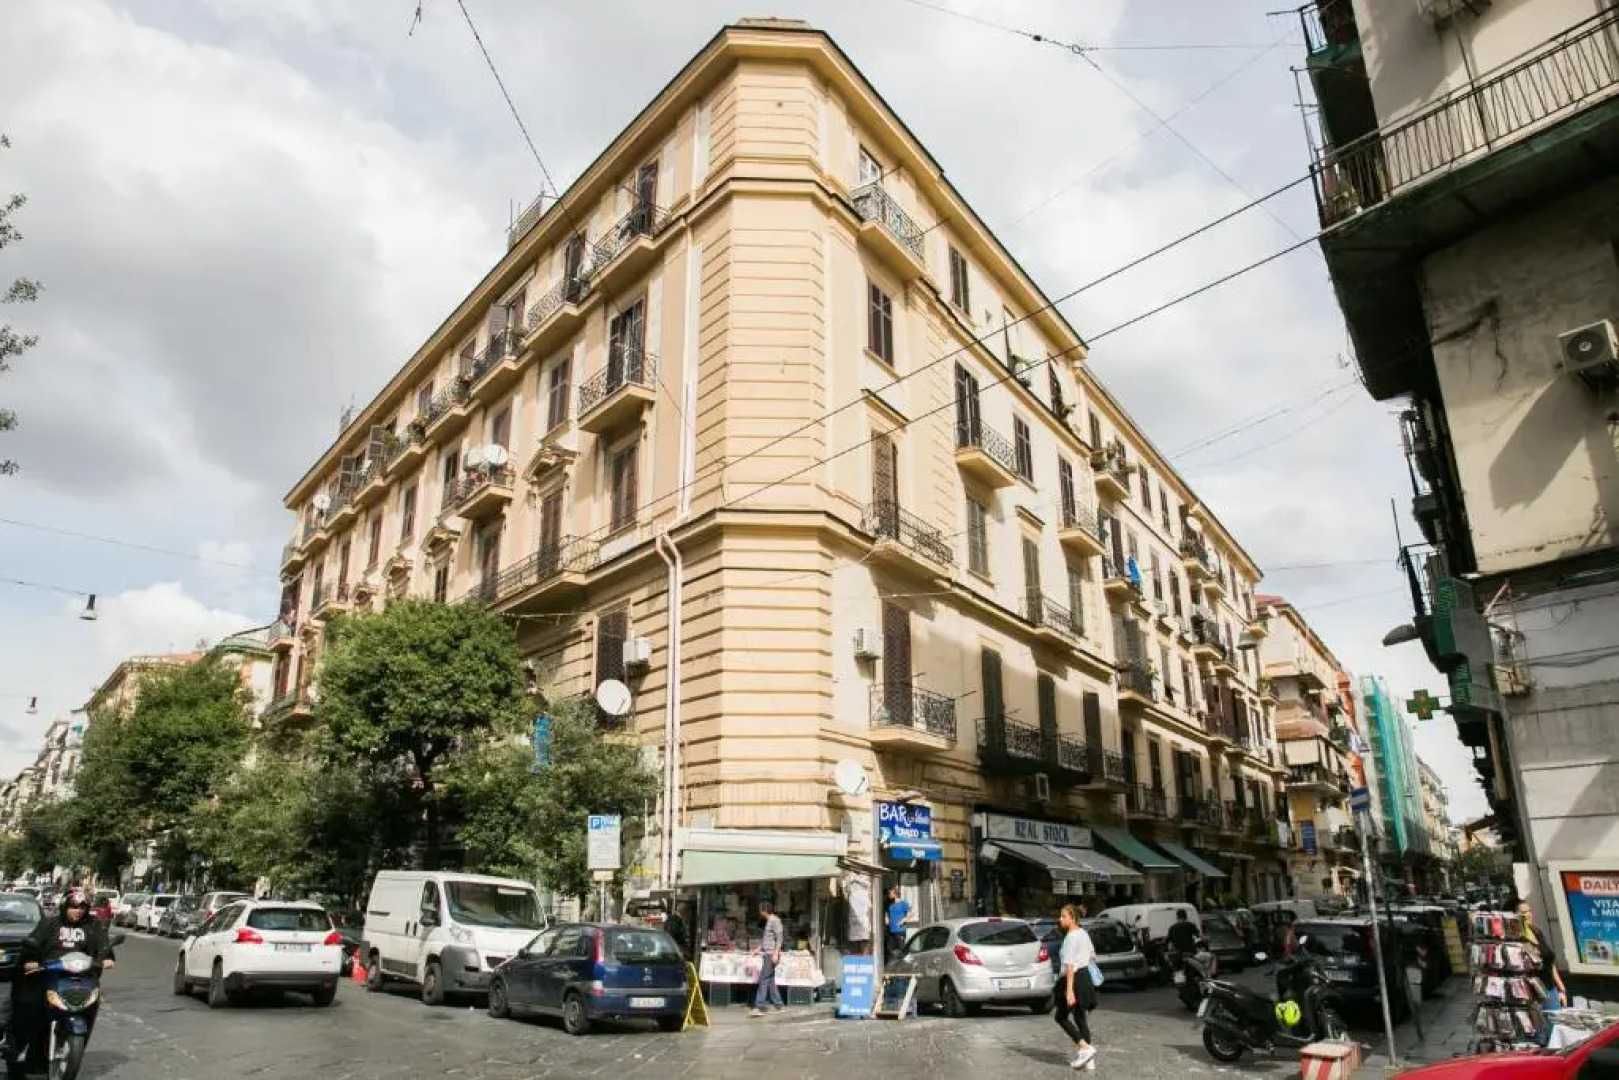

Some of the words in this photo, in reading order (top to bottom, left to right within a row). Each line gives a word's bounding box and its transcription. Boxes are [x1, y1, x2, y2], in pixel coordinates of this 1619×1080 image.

[880, 803, 910, 827] BAR
[1014, 821, 1037, 839] REAL
[1043, 824, 1070, 844] STOCK
[1583, 880, 1619, 891] DAILY
